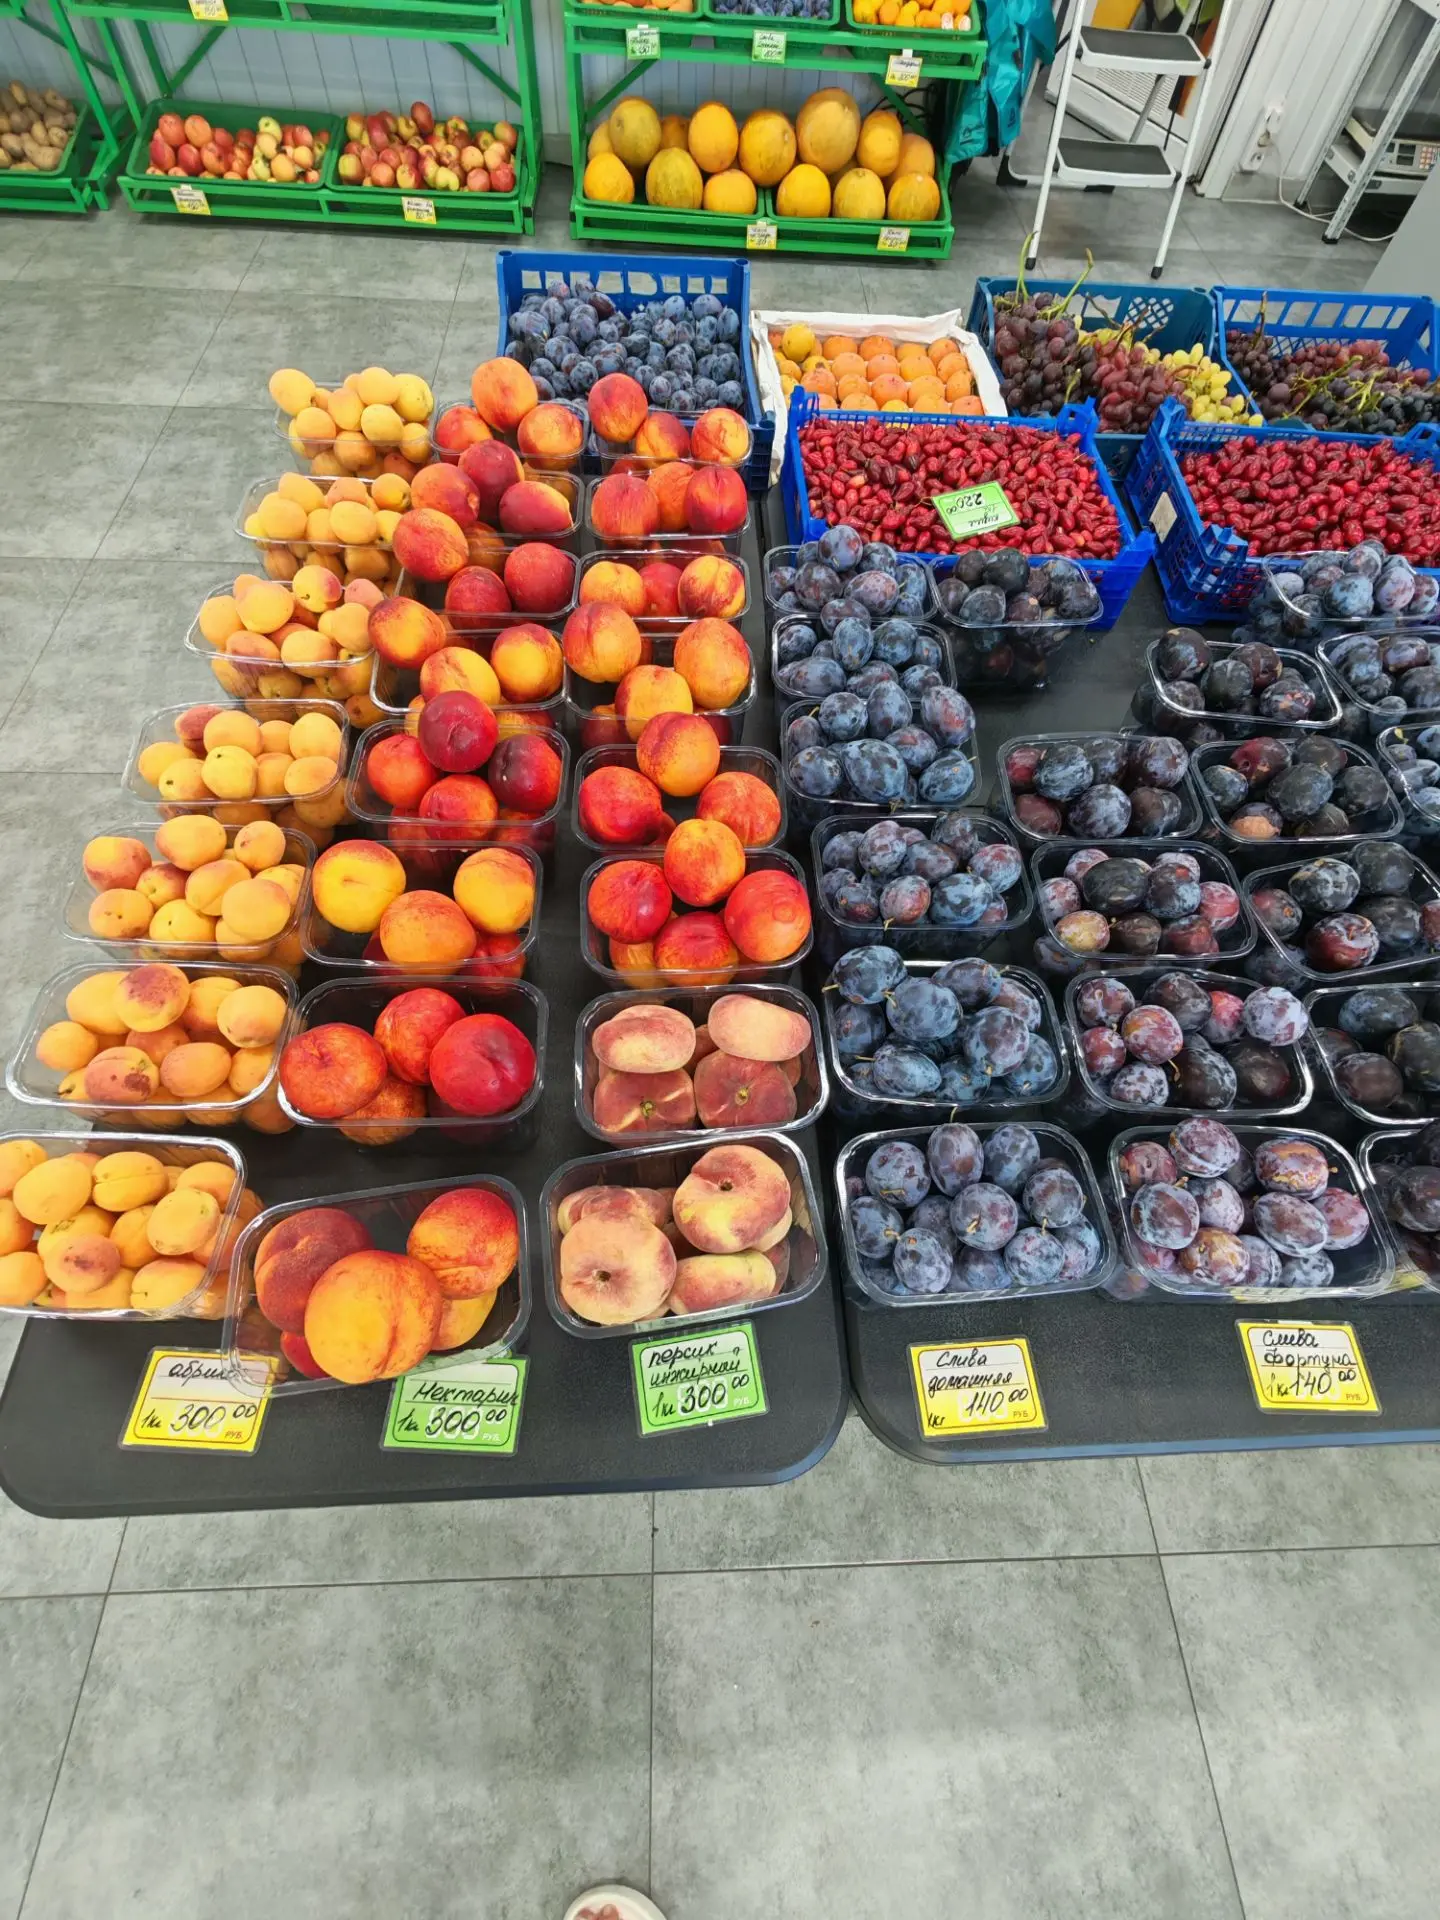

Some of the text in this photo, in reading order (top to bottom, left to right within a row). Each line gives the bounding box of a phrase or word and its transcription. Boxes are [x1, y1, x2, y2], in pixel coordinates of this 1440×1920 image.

[956, 492, 982, 508] 220
[648, 1341, 718, 1369] персик
[680, 1383, 726, 1414] 300
[731, 1374, 750, 1389] 00
[928, 1372, 1013, 1398] домашняя
[1289, 1369, 1332, 1396] 140
[1338, 1370, 1357, 1382] 00
[965, 1388, 1029, 1416] 140 00
[170, 1403, 226, 1431] 300
[232, 1404, 258, 1418] 00
[425, 1407, 481, 1436] 300
[485, 1409, 507, 1422] 00
